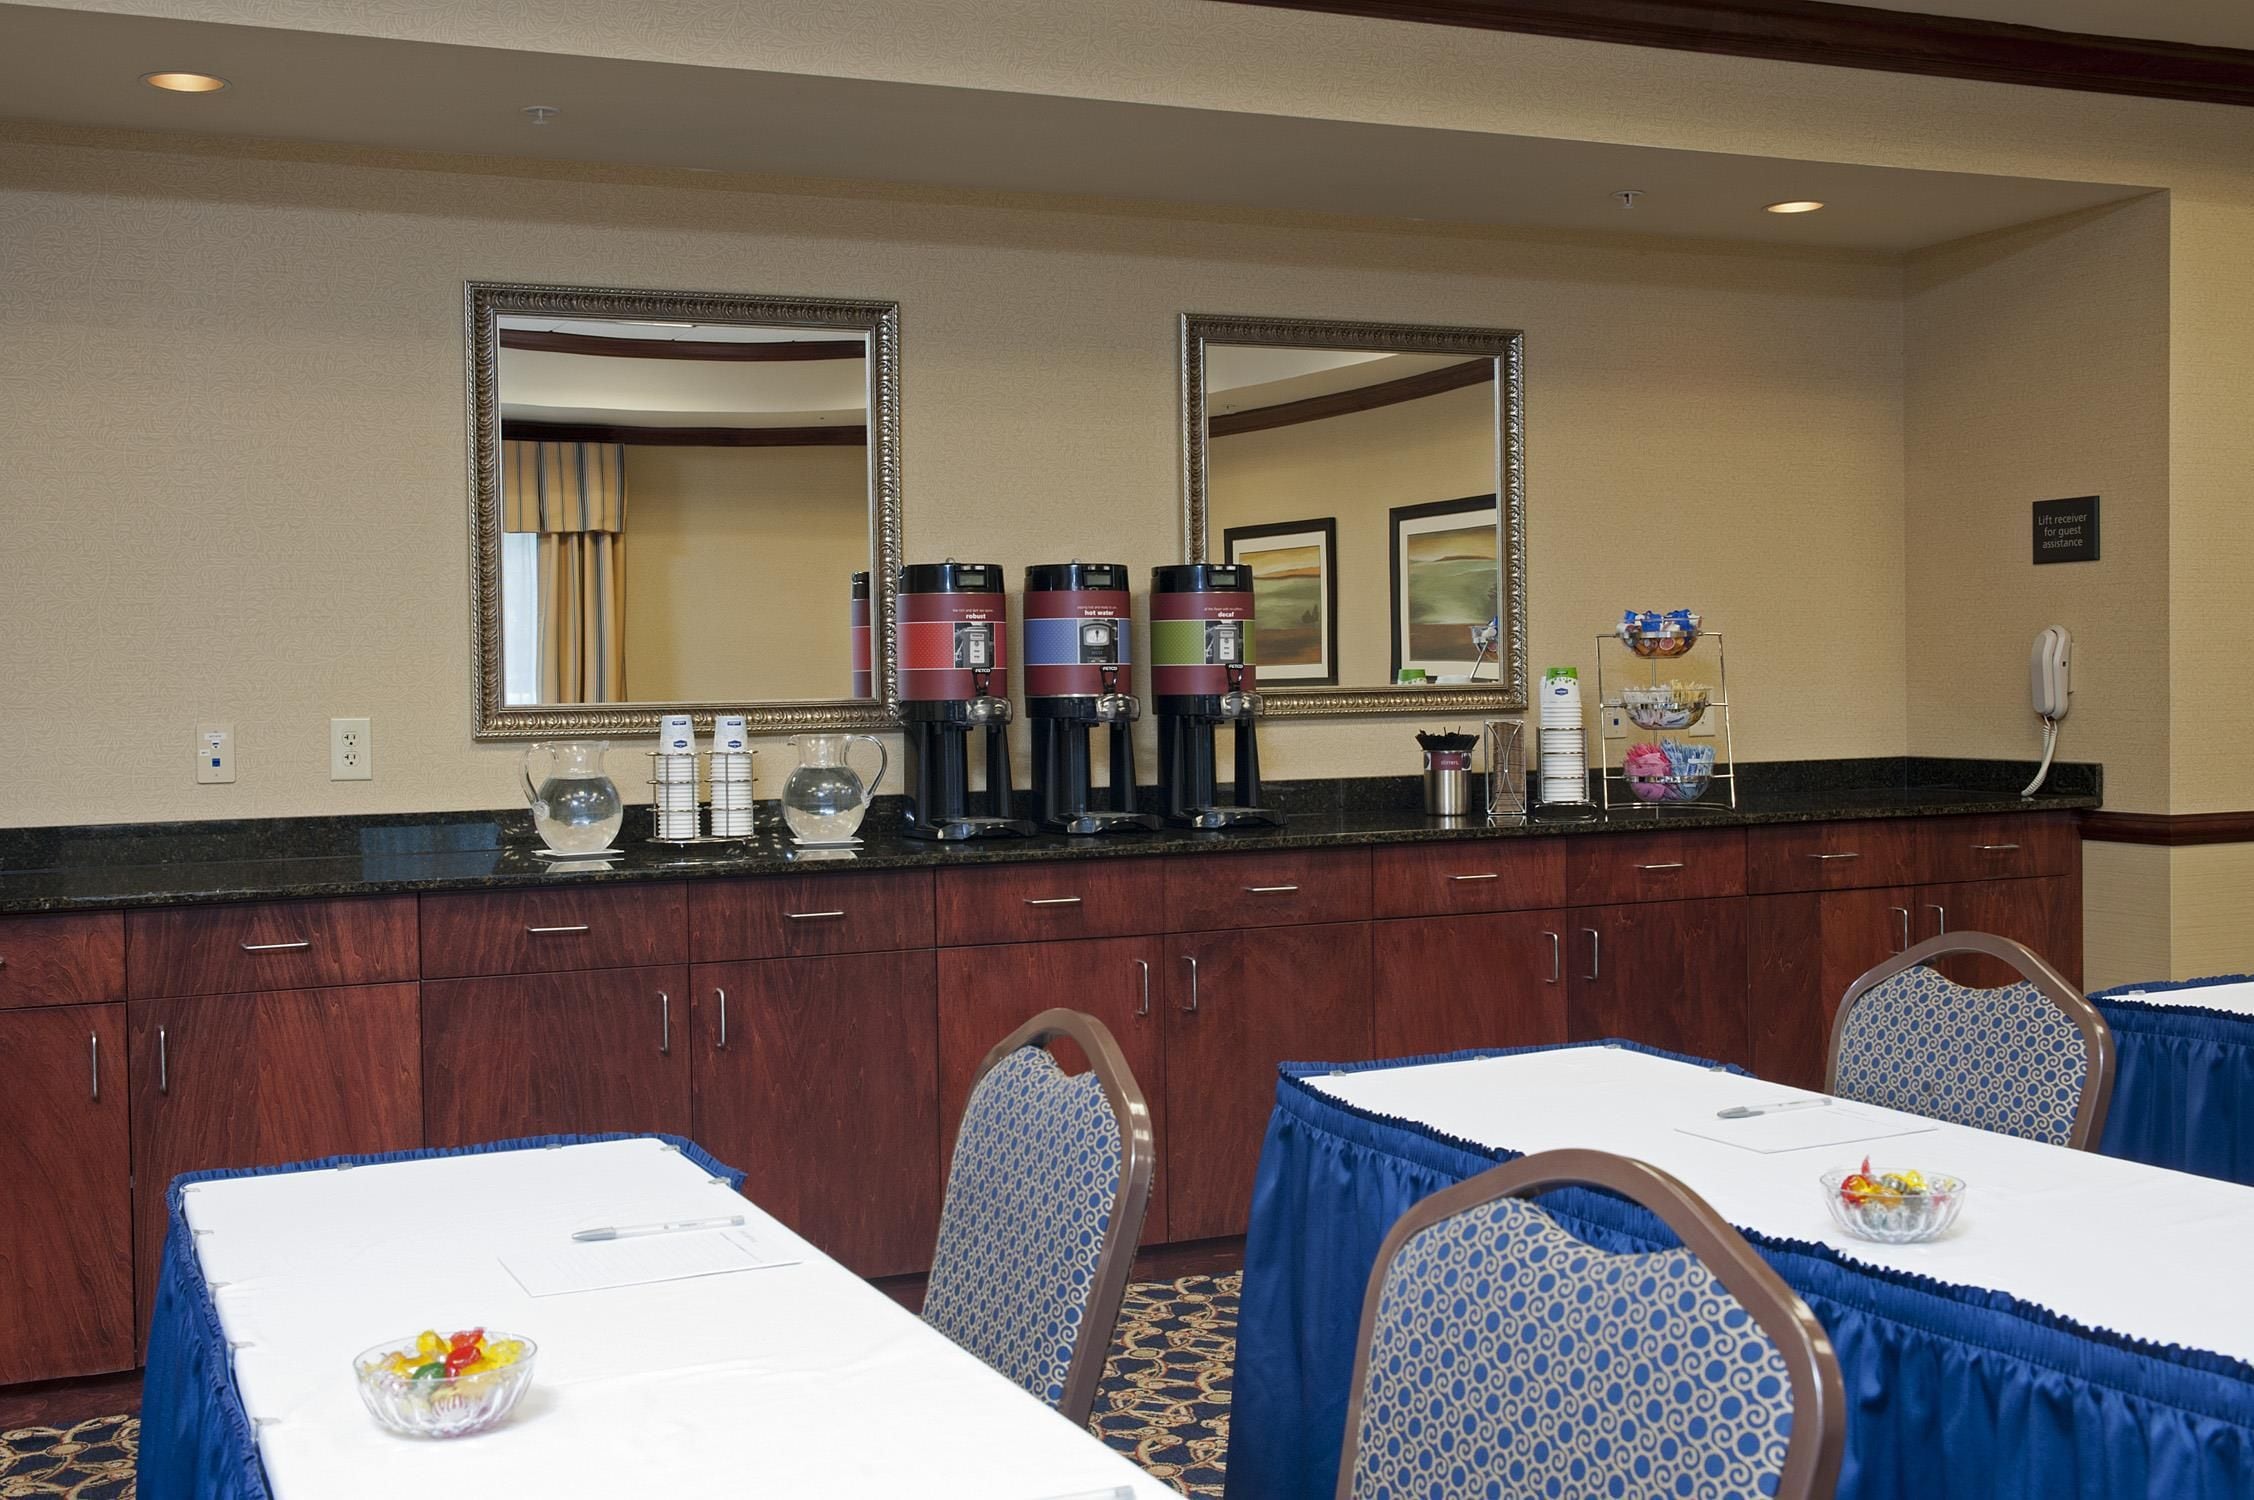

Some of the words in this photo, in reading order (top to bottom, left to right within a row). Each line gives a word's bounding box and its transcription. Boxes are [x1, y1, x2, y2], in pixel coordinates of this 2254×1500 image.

[2038, 514, 2053, 526] Lift
[2054, 513, 2087, 525] receiver
[2044, 526, 2057, 537] for
[2058, 526, 2081, 538] guest
[2042, 538, 2084, 549] assistance
